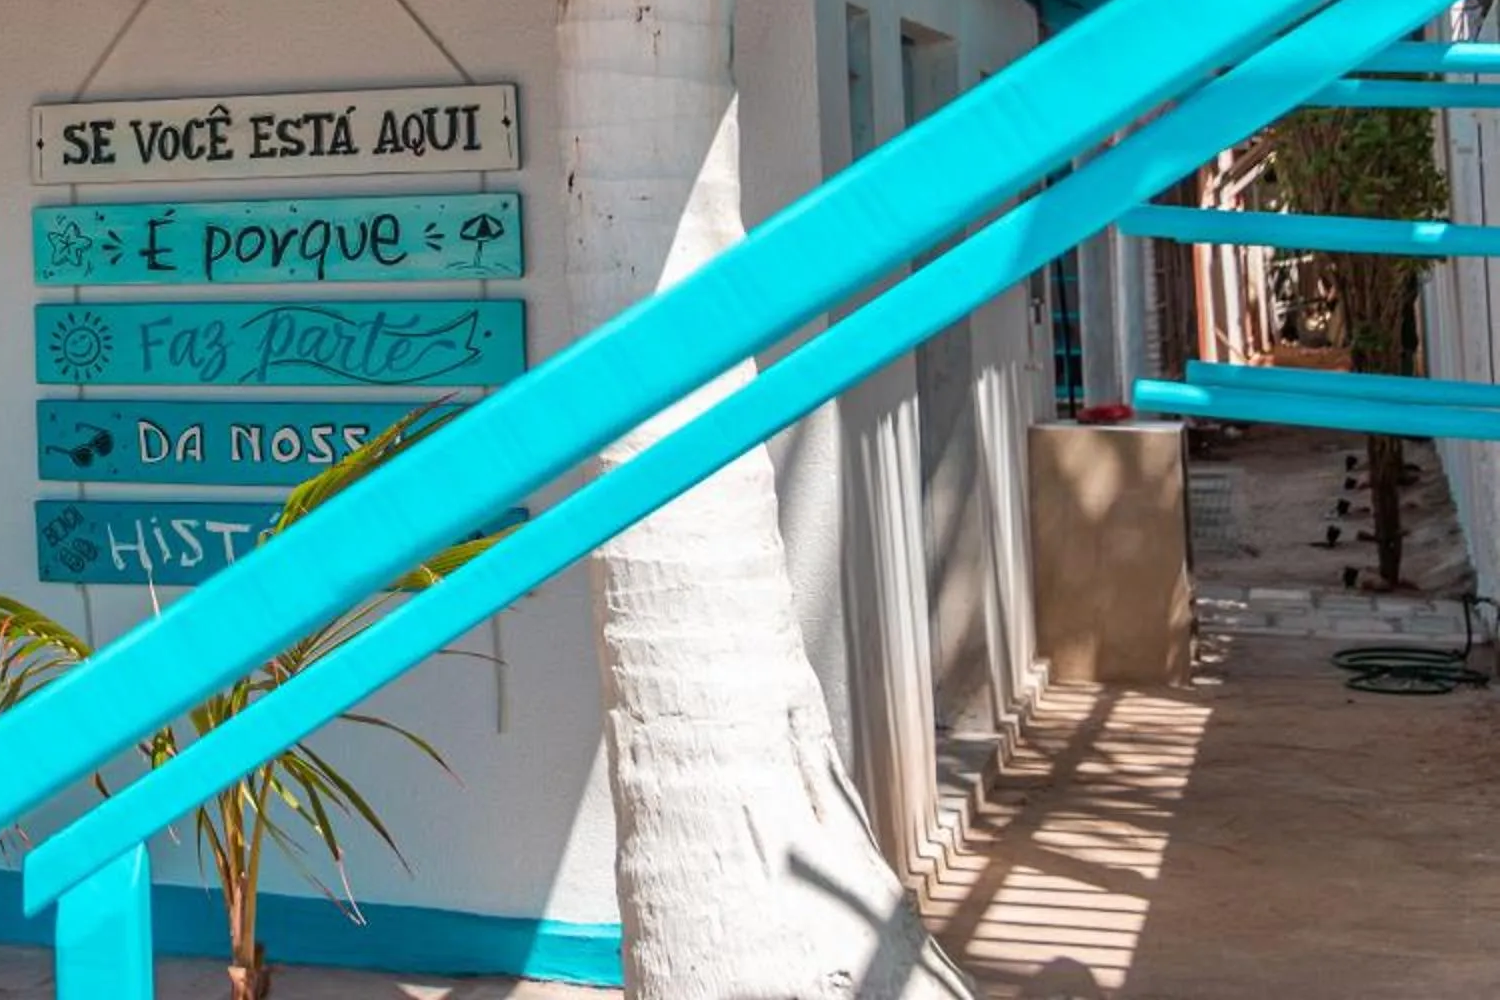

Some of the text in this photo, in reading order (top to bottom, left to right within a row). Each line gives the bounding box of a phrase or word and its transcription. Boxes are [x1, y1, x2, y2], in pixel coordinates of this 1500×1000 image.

[62, 103, 483, 166] SE VOCÊ ESTÁ AQUI
[137, 209, 409, 281] É porque
[138, 316, 235, 382] Faz
[136, 420, 403, 466] DA NOSS
